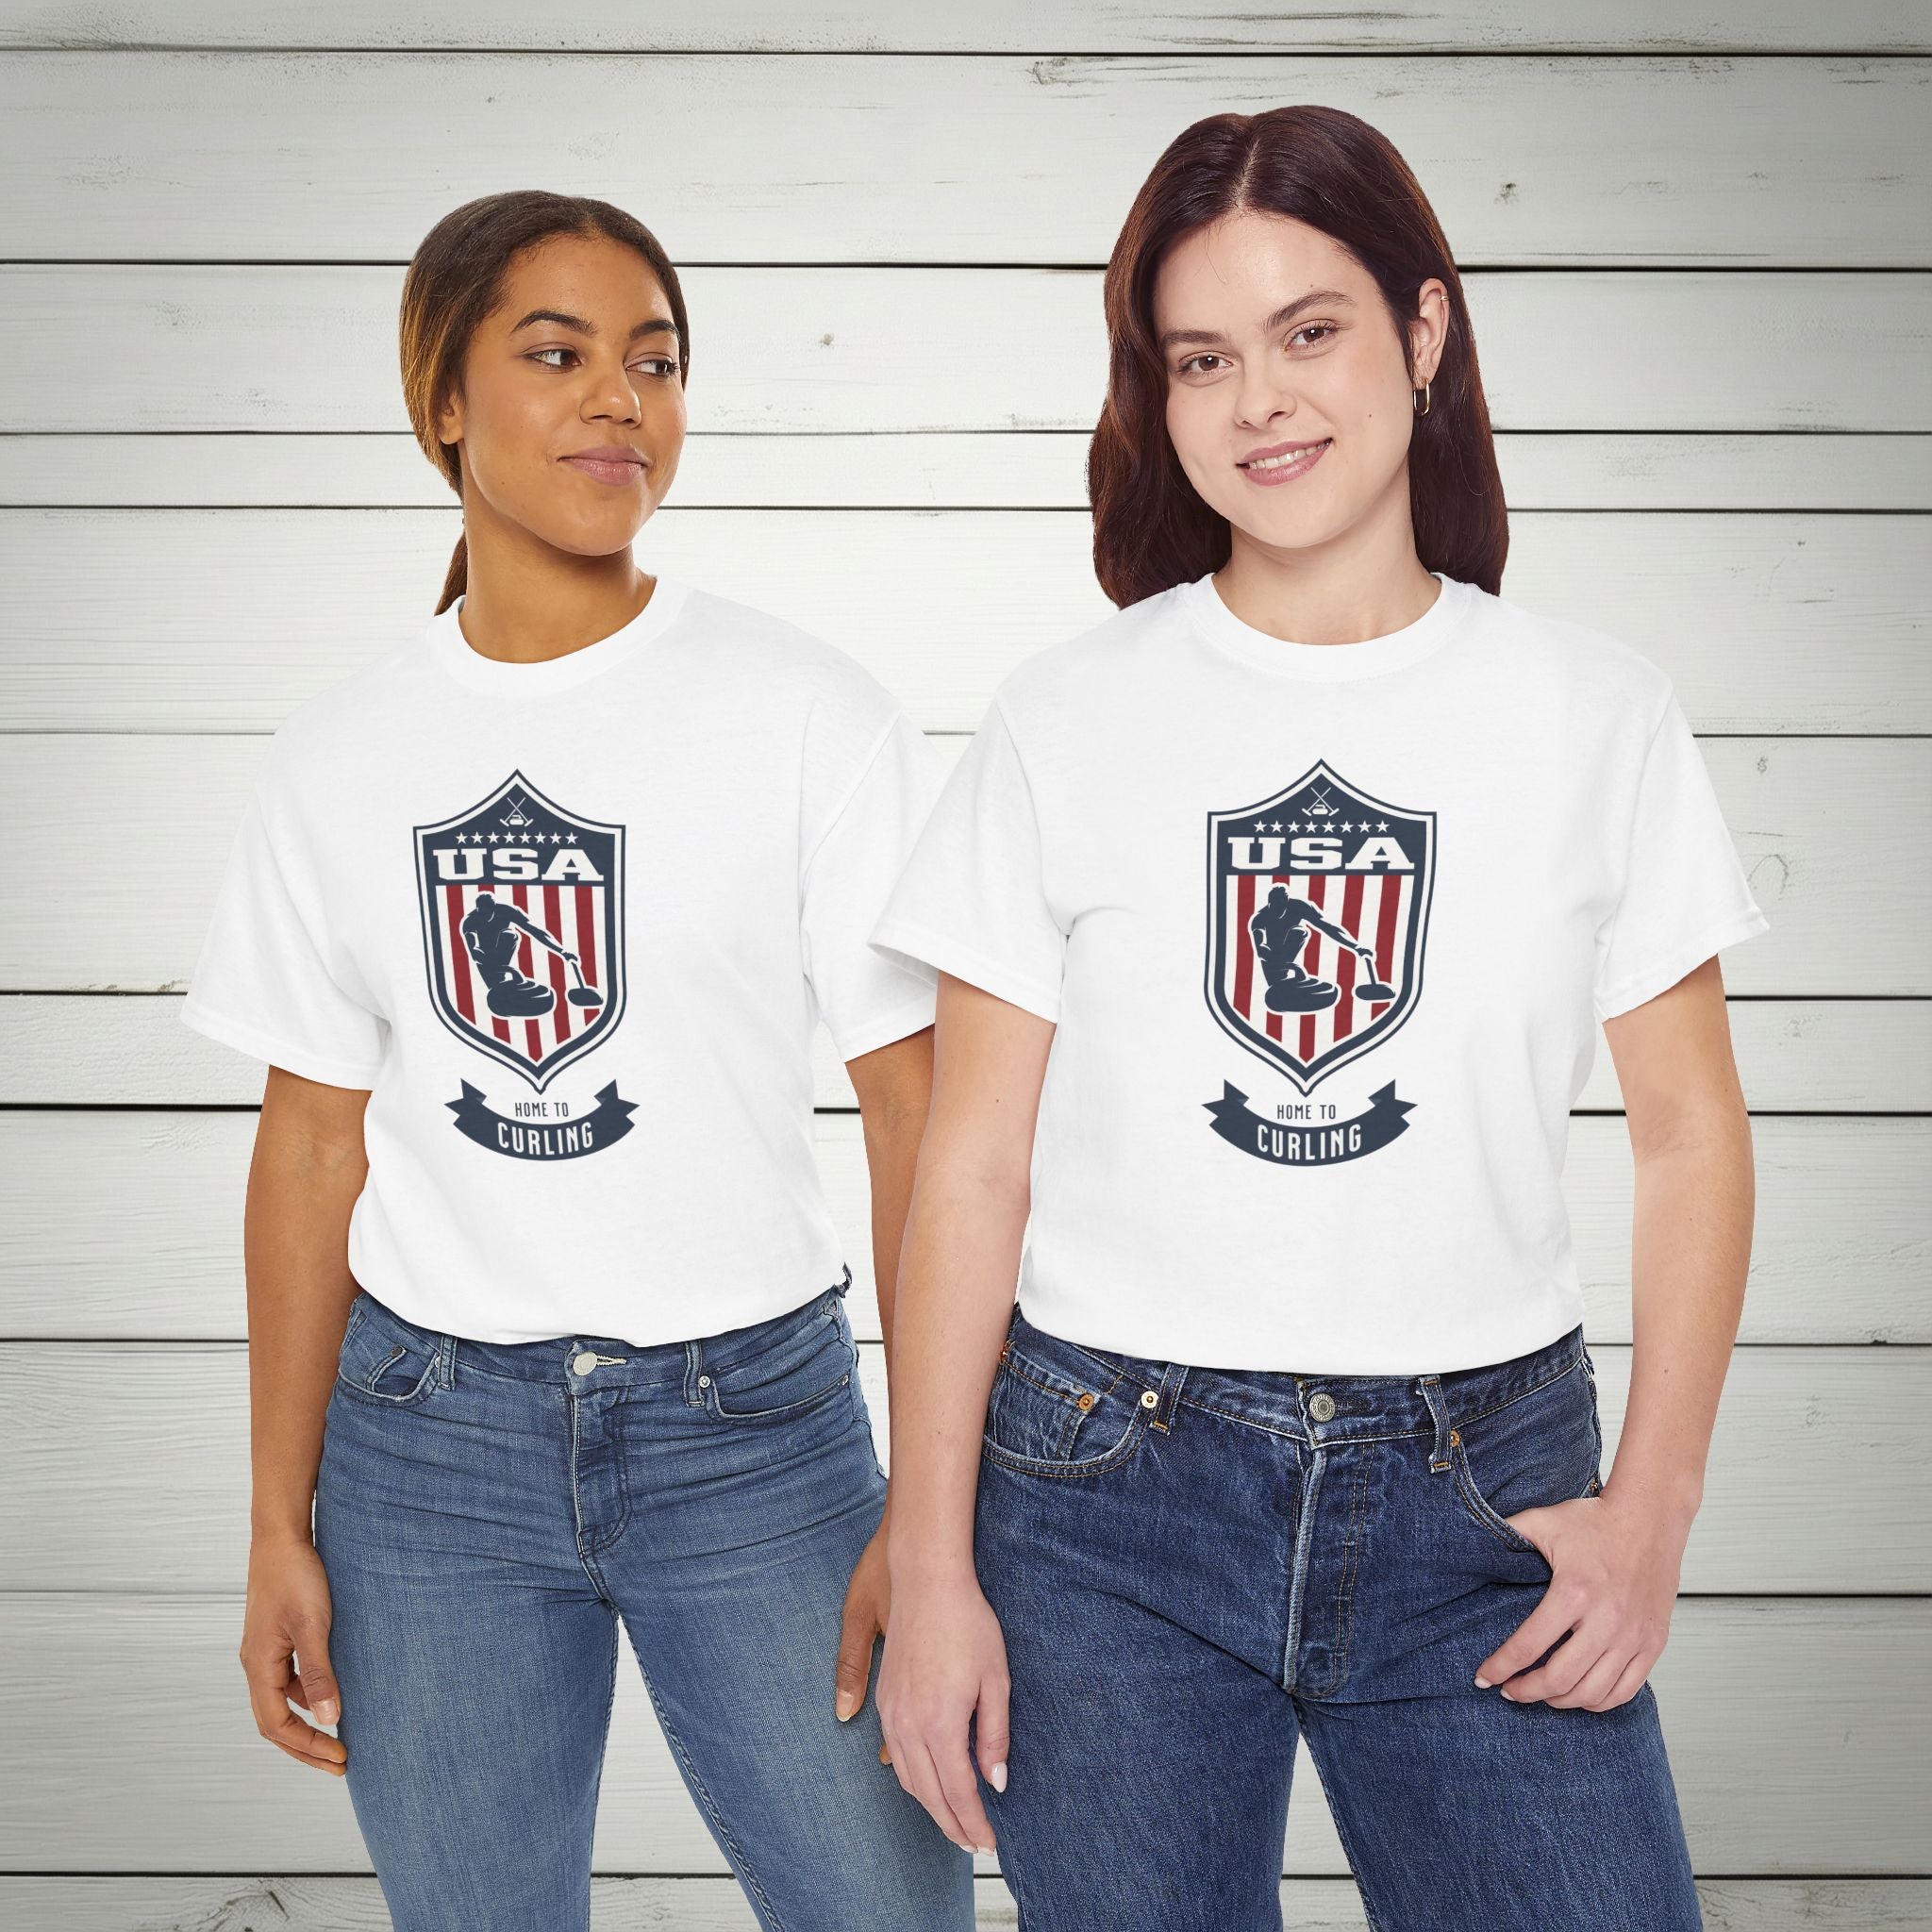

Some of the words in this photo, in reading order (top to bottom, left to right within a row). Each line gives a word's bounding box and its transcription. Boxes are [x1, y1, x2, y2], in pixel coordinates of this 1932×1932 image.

[433, 849, 604, 880] USA
[1228, 837, 1414, 870] USA
[514, 1101, 548, 1118] HOME
[553, 1101, 570, 1118] TO
[1276, 1104, 1312, 1120] HOME
[1319, 1104, 1337, 1120] TO
[497, 1122, 593, 1155] CURLING
[1257, 1124, 1361, 1160] CURLING
